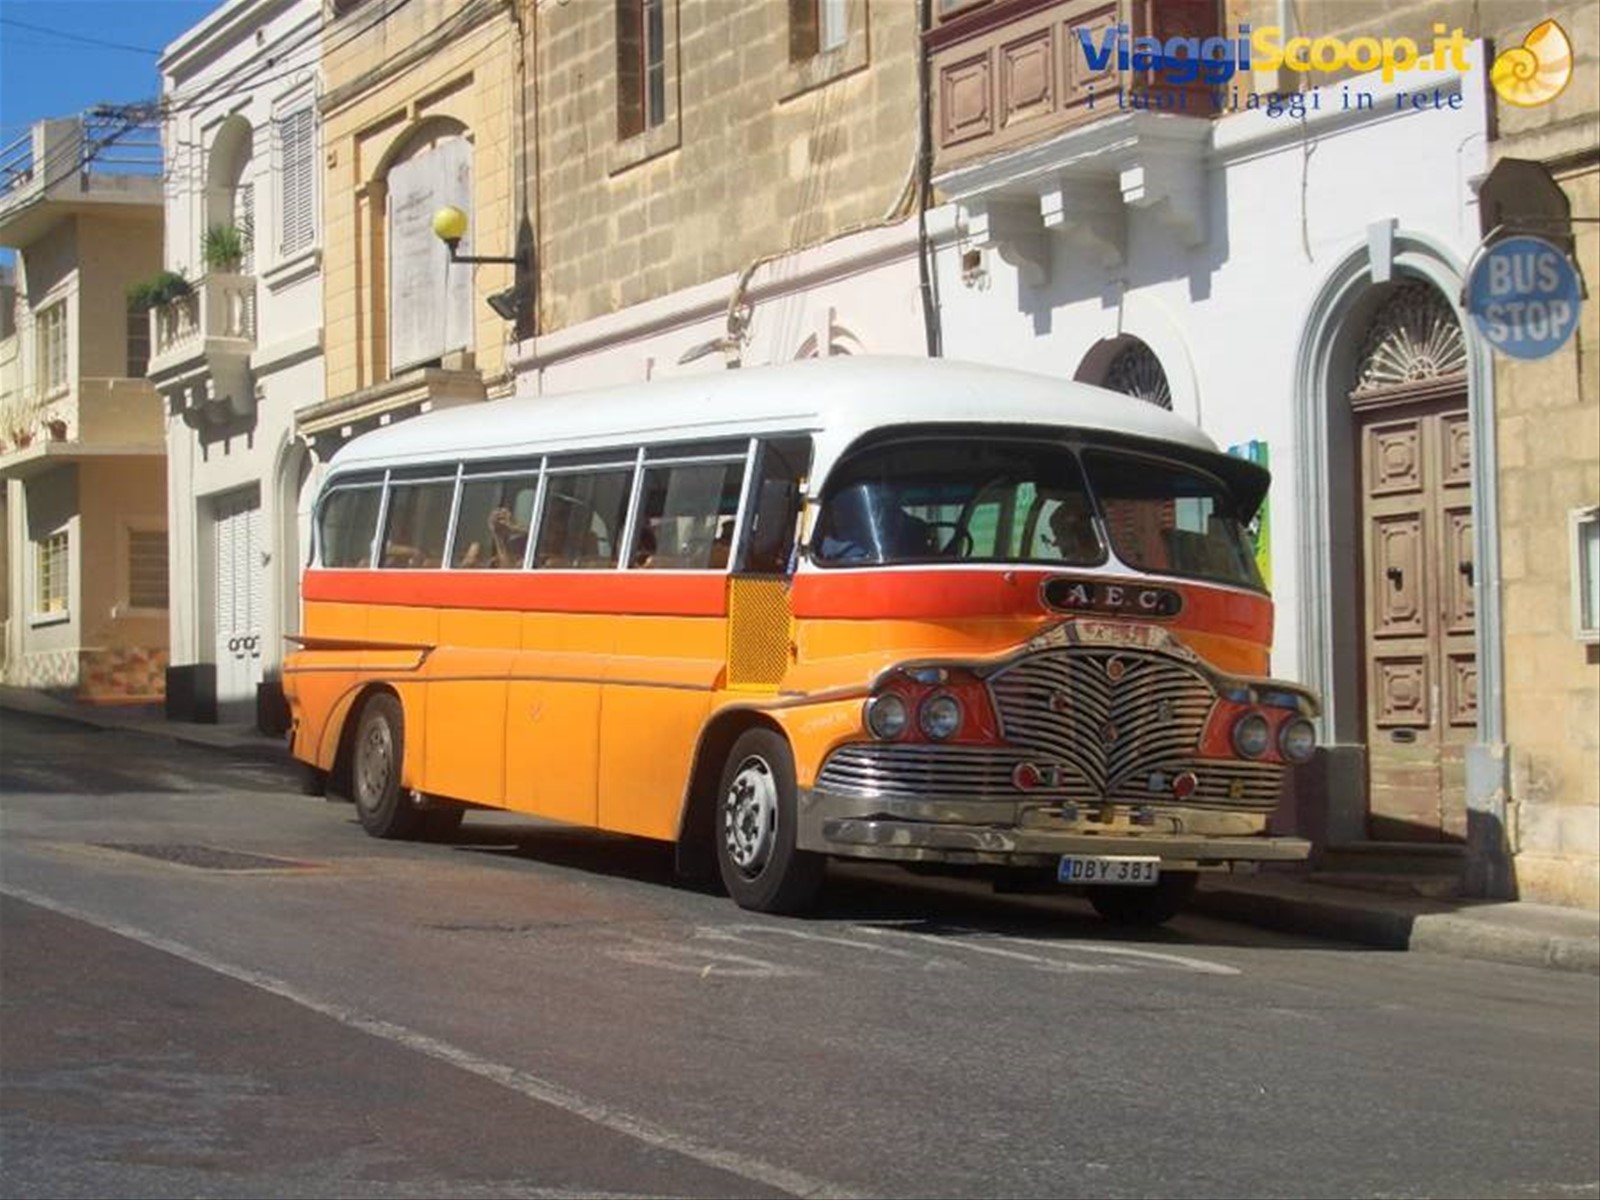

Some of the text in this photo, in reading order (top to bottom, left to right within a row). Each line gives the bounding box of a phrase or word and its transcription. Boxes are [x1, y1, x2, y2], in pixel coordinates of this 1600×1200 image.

[1488, 253, 1559, 295] BUS
[1486, 301, 1570, 342] STOP
[1072, 860, 1153, 880] DBY 381
